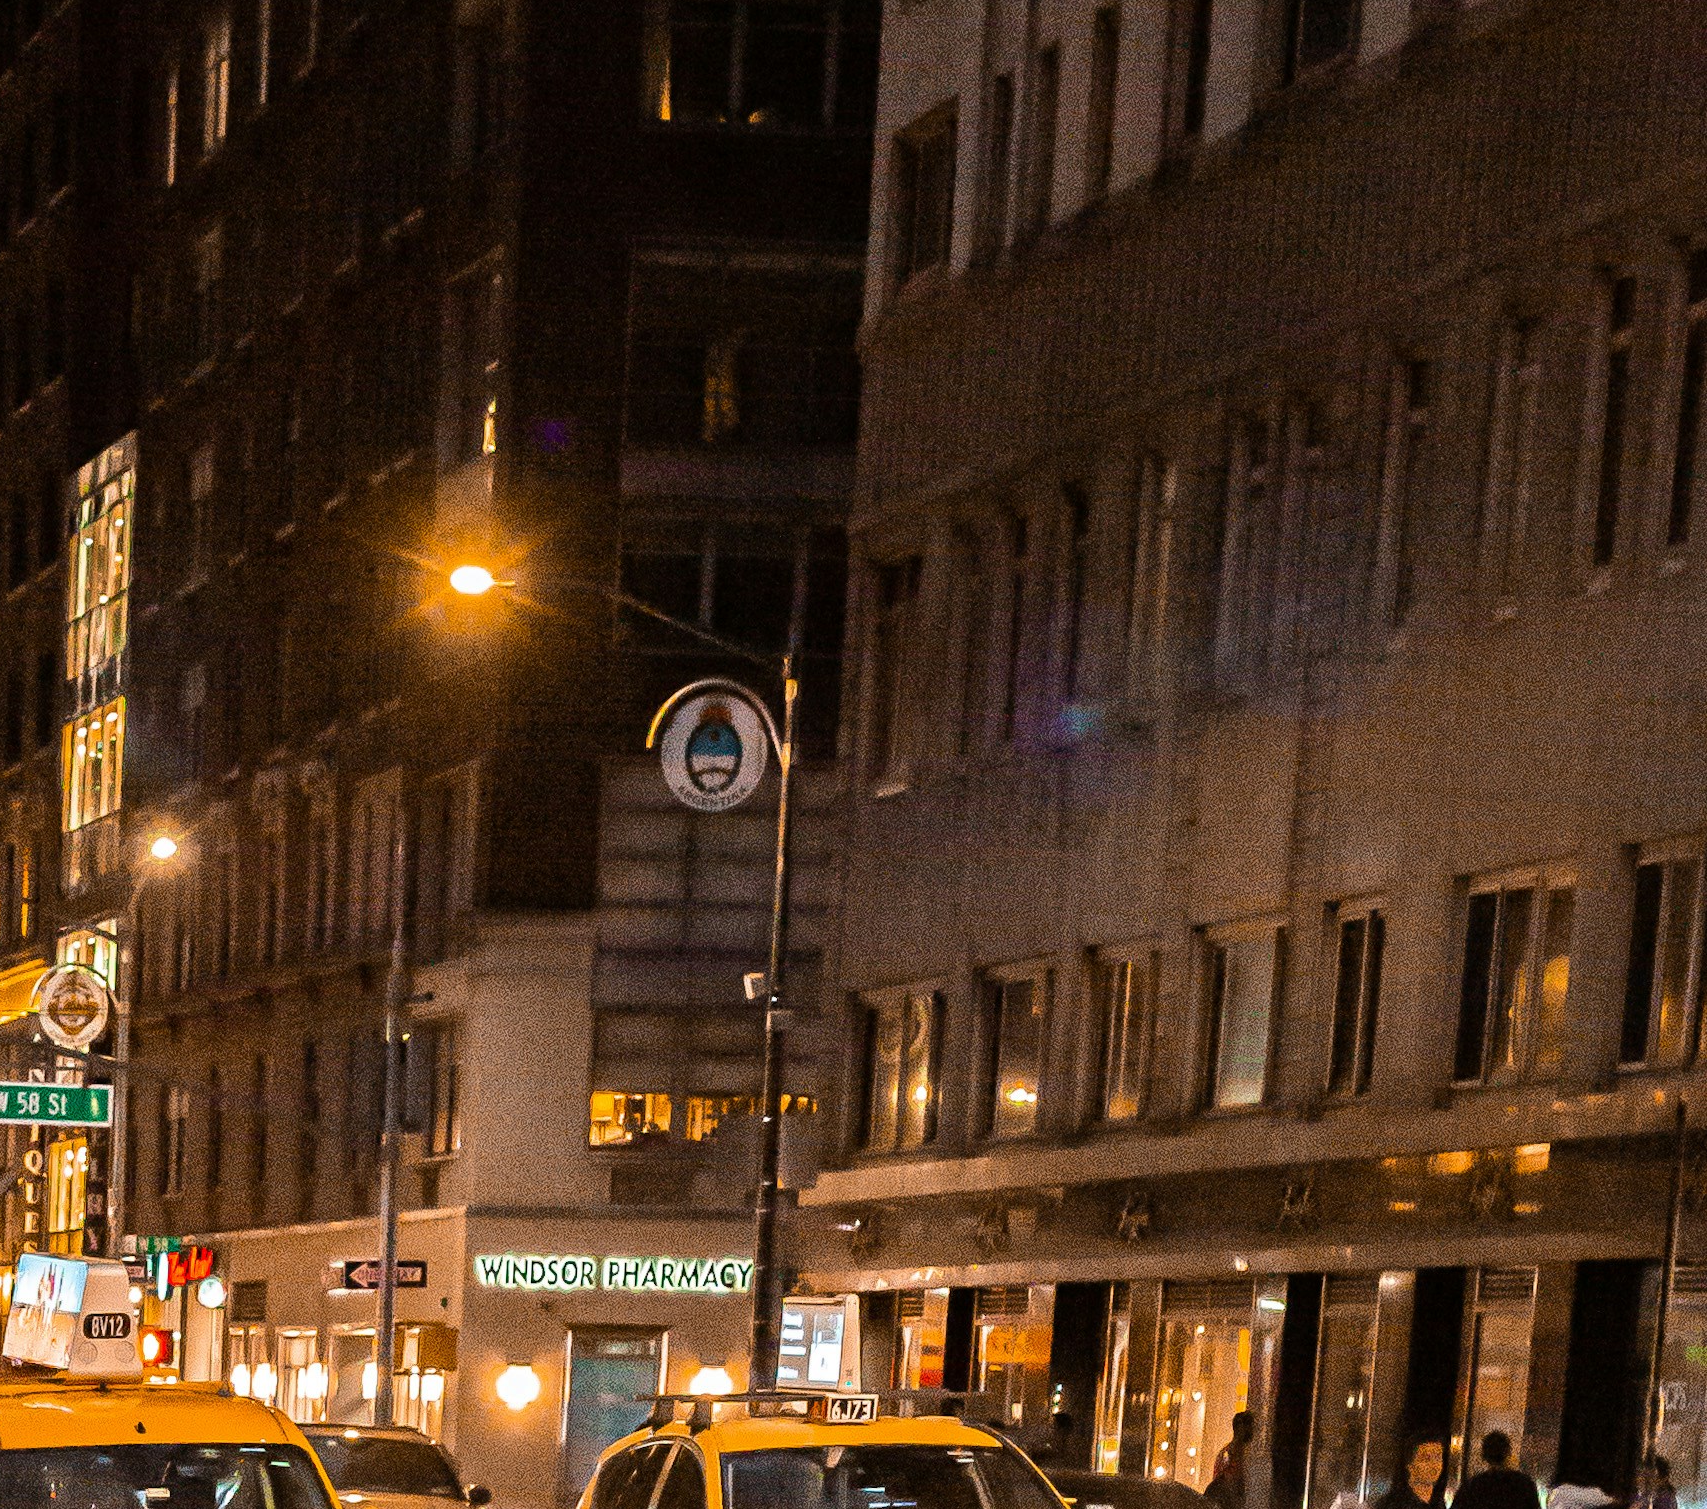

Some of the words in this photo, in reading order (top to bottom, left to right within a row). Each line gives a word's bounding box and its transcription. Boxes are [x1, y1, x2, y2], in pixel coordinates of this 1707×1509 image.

[17, 1092, 41, 1115] 58
[48, 1093, 68, 1116] St
[480, 1257, 594, 1287] WINDSOR
[608, 1260, 753, 1289] PHARMACY
[92, 1315, 124, 1338] 8V12
[832, 1400, 872, 1420] 6J73
